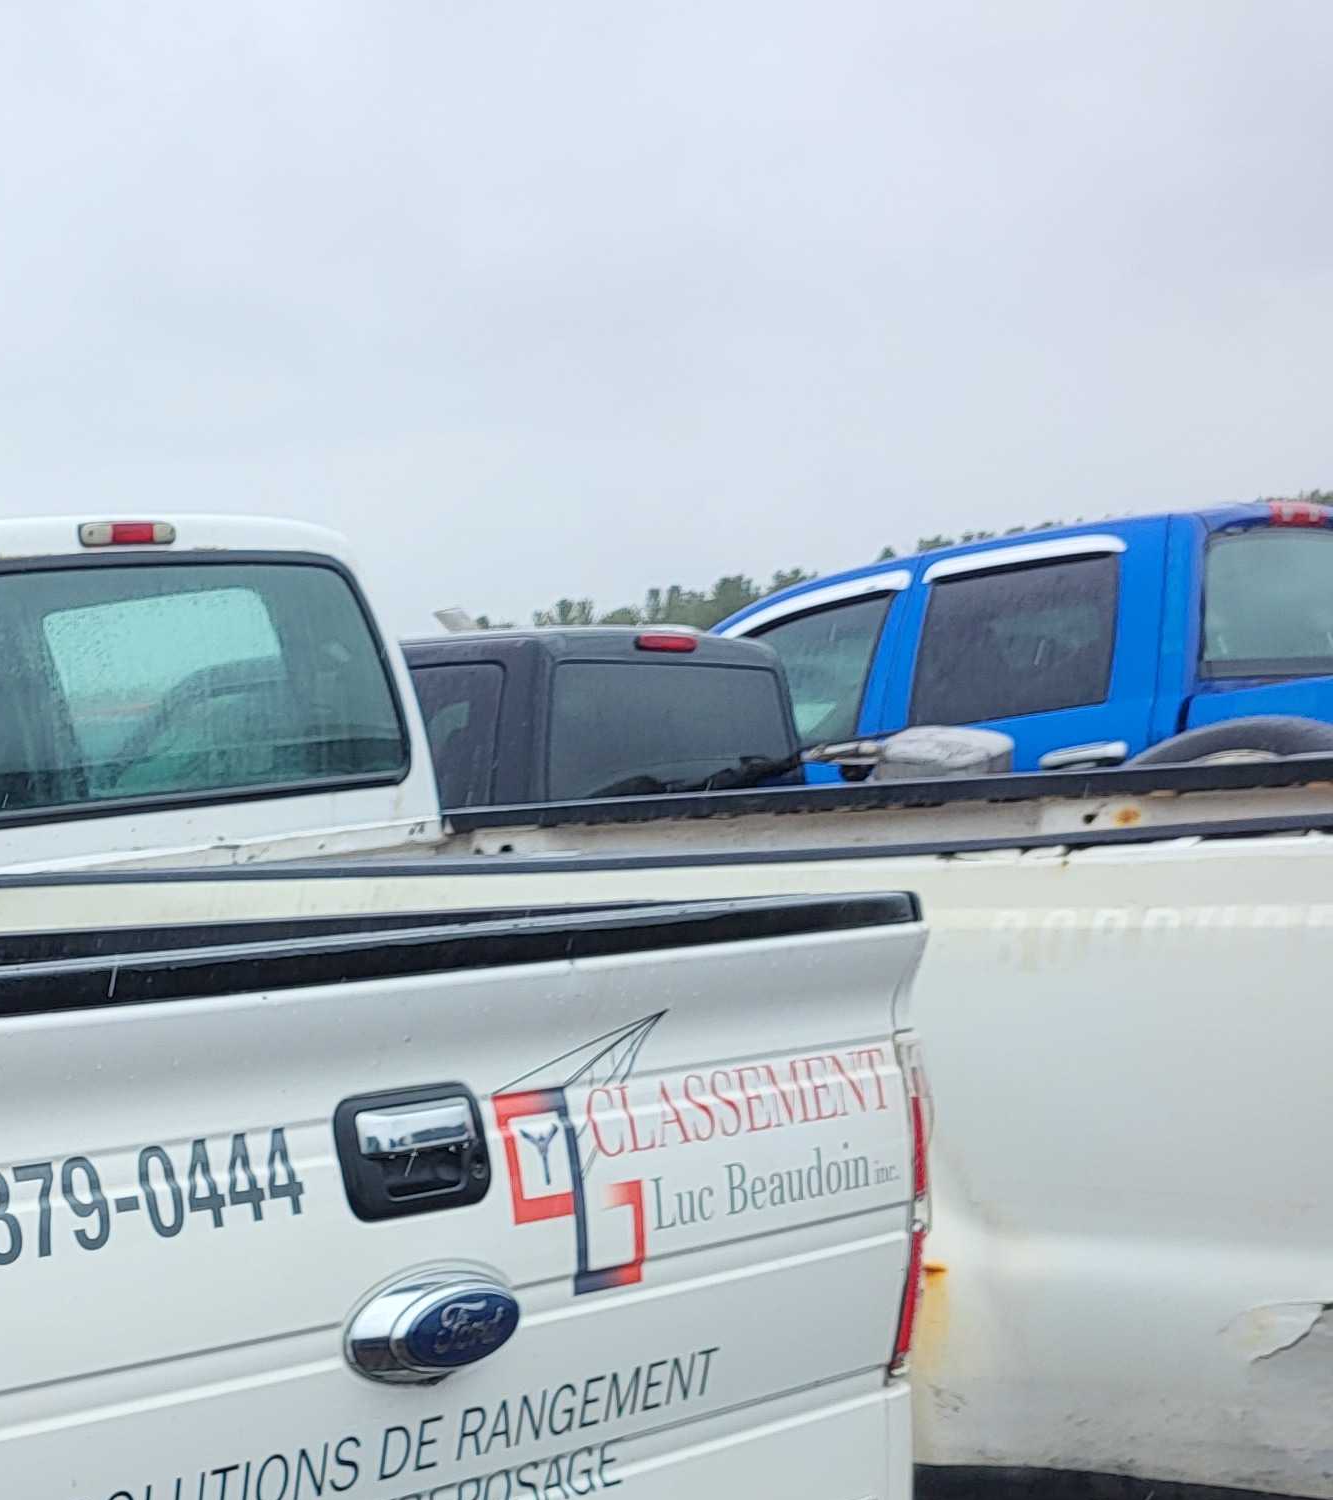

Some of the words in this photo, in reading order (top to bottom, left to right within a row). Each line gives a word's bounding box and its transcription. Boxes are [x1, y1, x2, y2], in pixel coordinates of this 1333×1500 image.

[585, 1047, 891, 1159] CLASSEMENT
[652, 1176, 715, 1231] Luc
[723, 1142, 870, 1216] Beaudoin
[434, 1299, 505, 1355] Ford
[377, 1415, 444, 1482] DE
[455, 1347, 721, 1464] RANGEMENT
